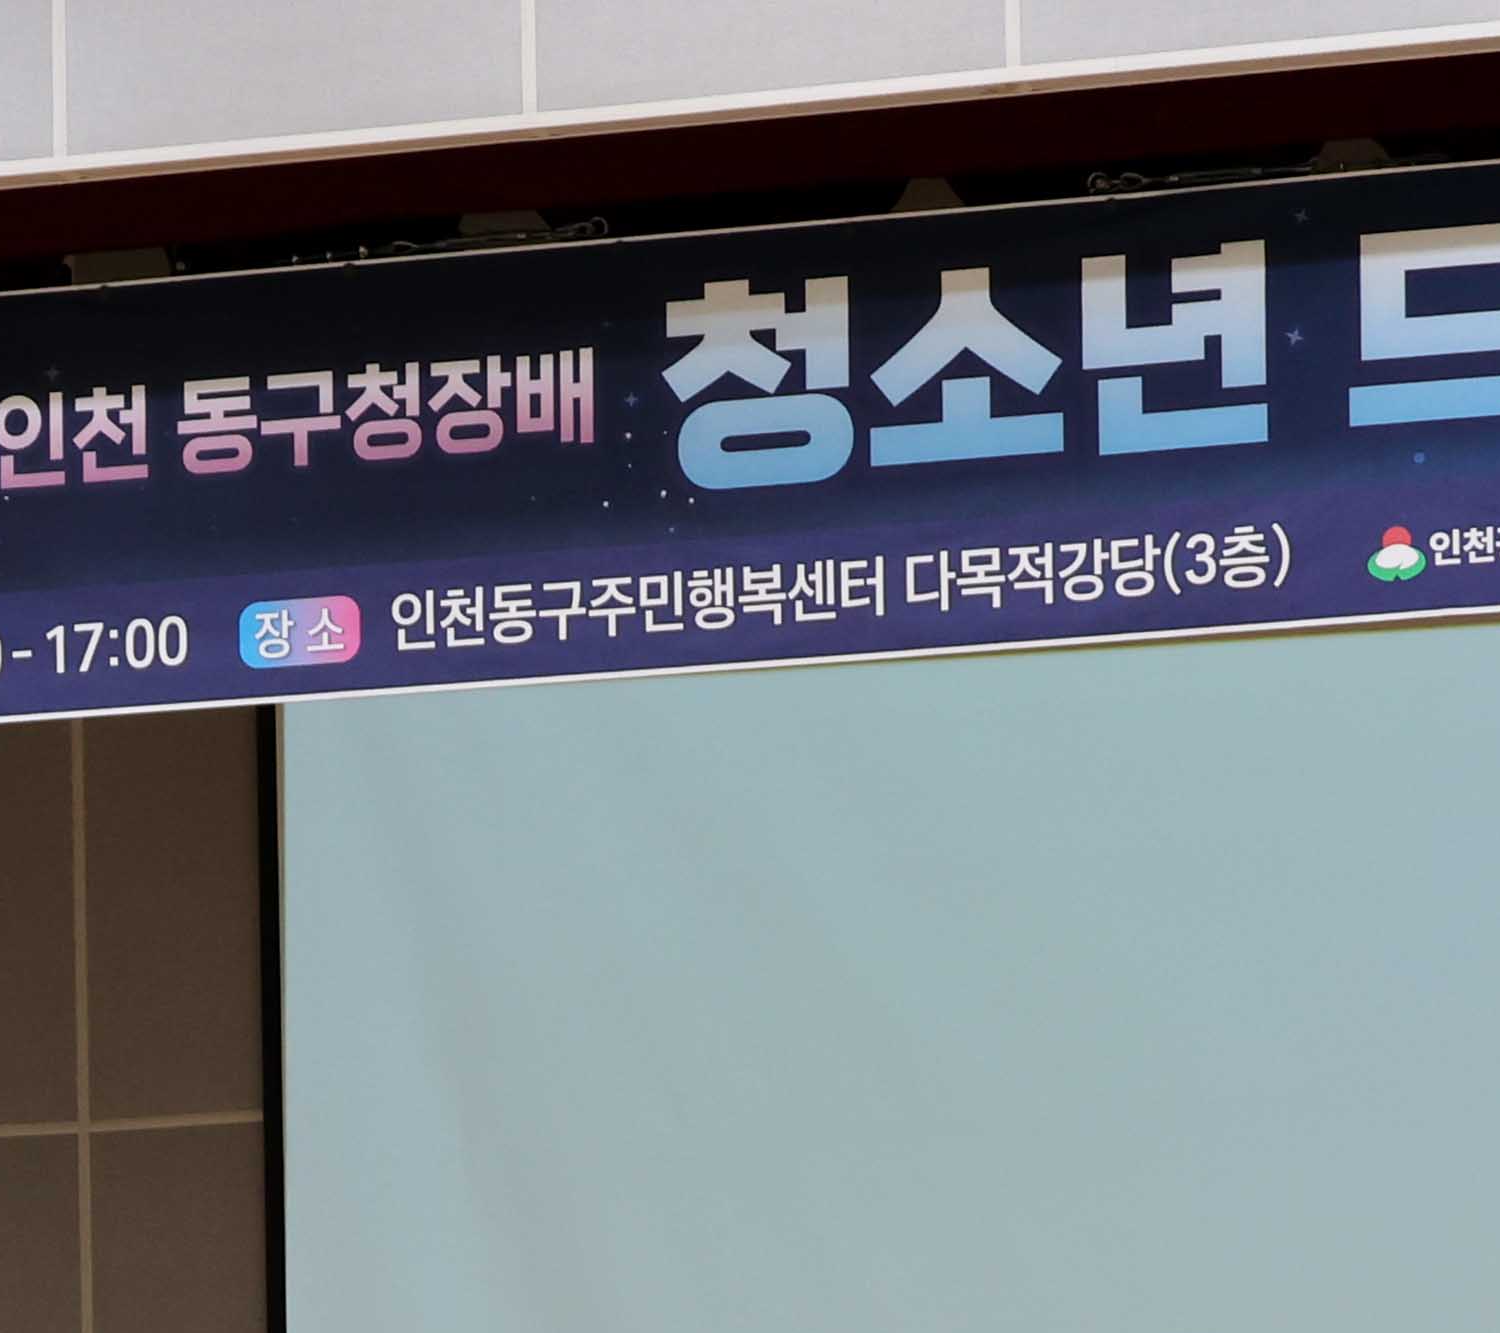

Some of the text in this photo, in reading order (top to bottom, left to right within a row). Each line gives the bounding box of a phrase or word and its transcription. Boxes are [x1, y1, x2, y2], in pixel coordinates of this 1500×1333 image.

[176, 346, 594, 474] 동구청장배
[660, 238, 1270, 492] 청소년
[389, 522, 1290, 653] 인천동구주민행복센터 다목적강당(3층)
